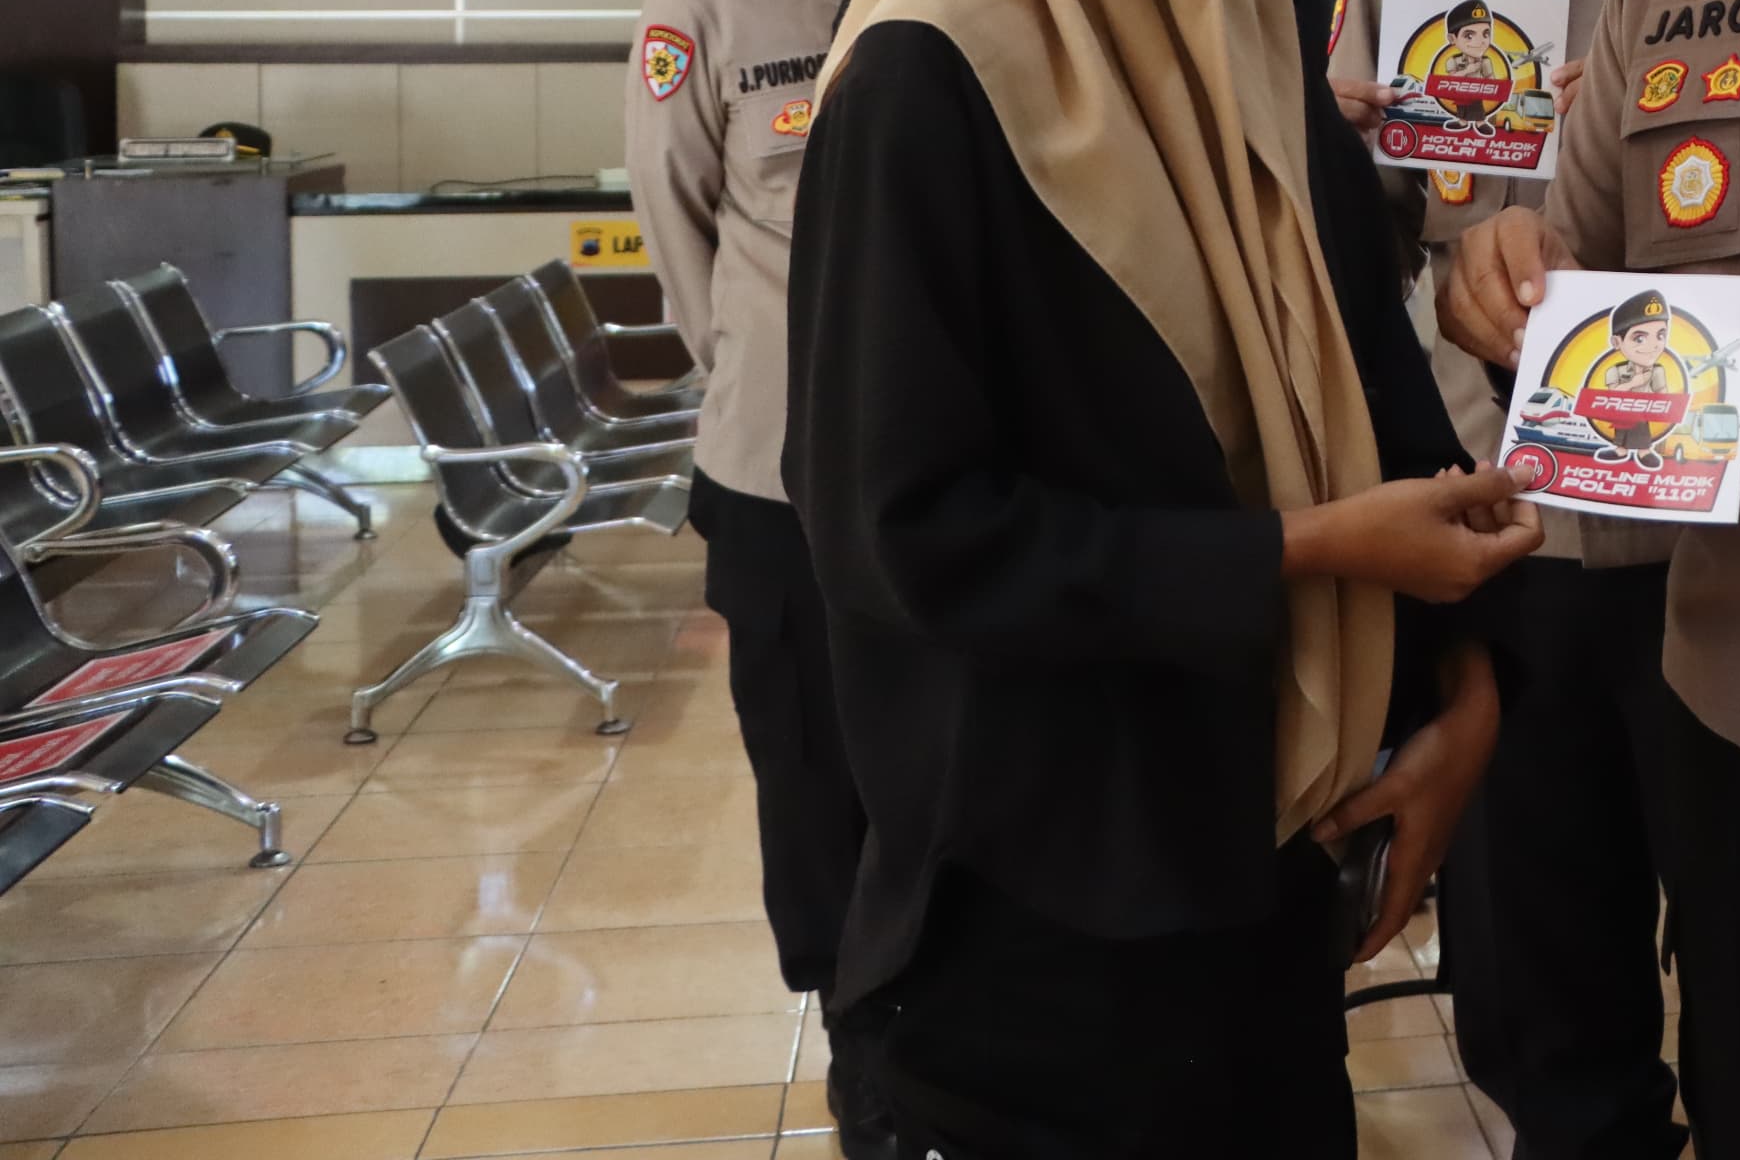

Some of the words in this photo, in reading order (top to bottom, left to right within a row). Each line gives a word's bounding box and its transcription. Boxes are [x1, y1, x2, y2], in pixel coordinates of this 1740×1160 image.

[1437, 80, 1499, 95] PRESISI
[1422, 134, 1486, 148] HOTLINE
[1489, 140, 1537, 152] MUDIK
[1421, 144, 1476, 157] POLRI
[1485, 150, 1531, 161] "110"
[1591, 395, 1672, 414] PRESISI
[1563, 465, 1649, 485] HOTLINE
[1653, 474, 1715, 487] MUDIK
[1560, 477, 1636, 496] POLRI
[1649, 486, 1706, 502] "110"
